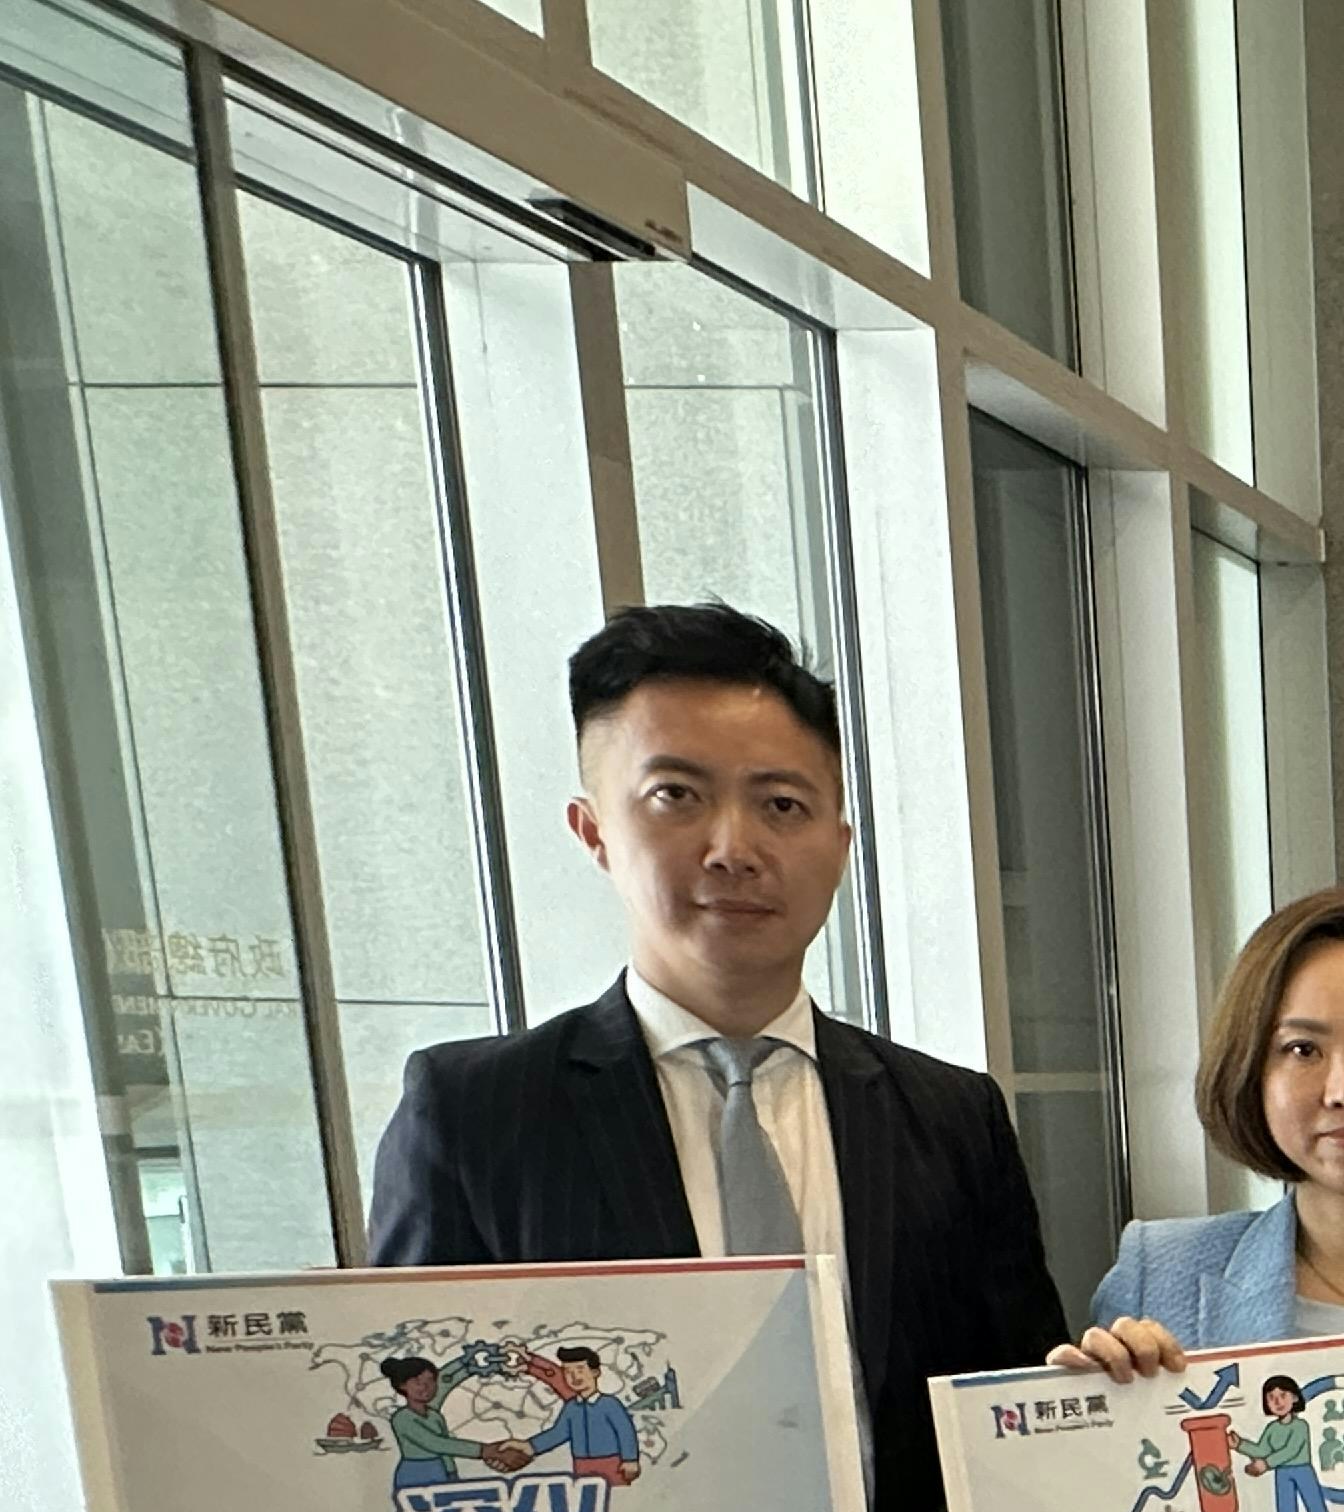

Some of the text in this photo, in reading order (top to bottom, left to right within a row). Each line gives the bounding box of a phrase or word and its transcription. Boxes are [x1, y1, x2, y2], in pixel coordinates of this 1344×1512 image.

[206, 1311, 308, 1338] 新民黨
[1034, 1395, 1109, 1421] 新民黨
